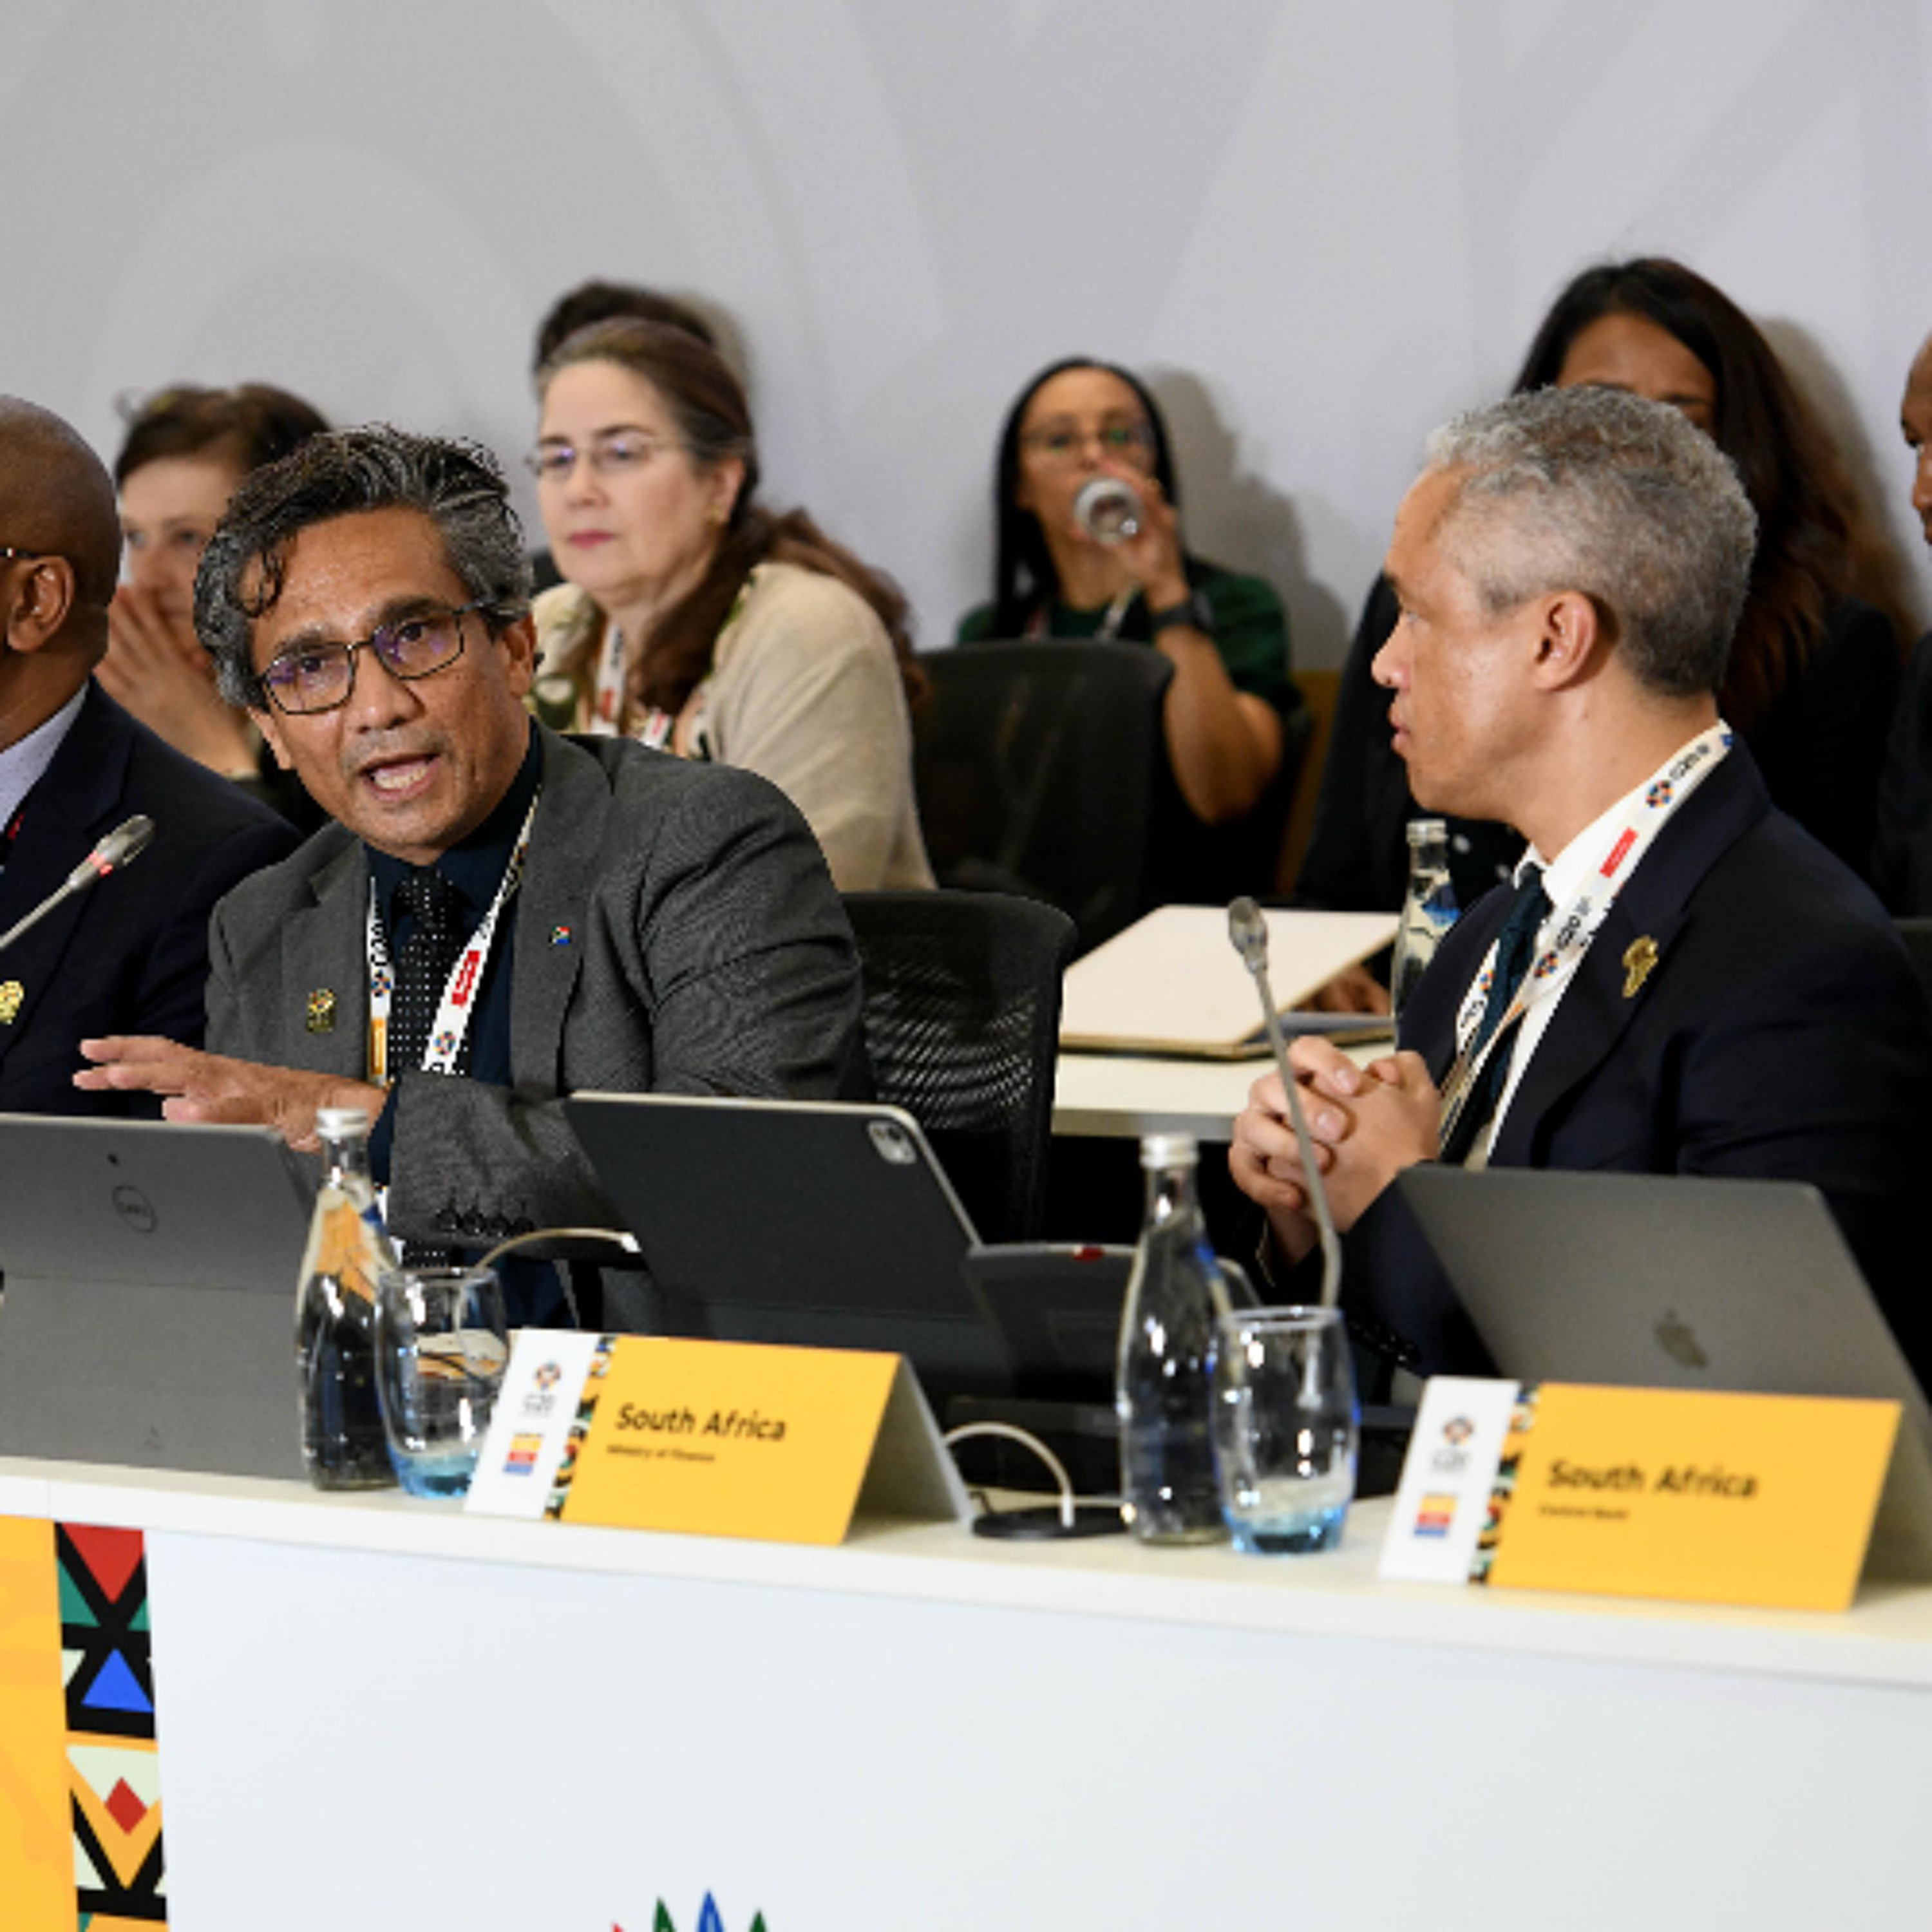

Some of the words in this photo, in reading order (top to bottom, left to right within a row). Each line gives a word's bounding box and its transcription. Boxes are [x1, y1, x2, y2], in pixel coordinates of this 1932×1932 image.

[615, 1402, 696, 1434] South
[701, 1408, 786, 1442] Africa
[1548, 1459, 1645, 1491] South
[1654, 1464, 1758, 1499] Africa
